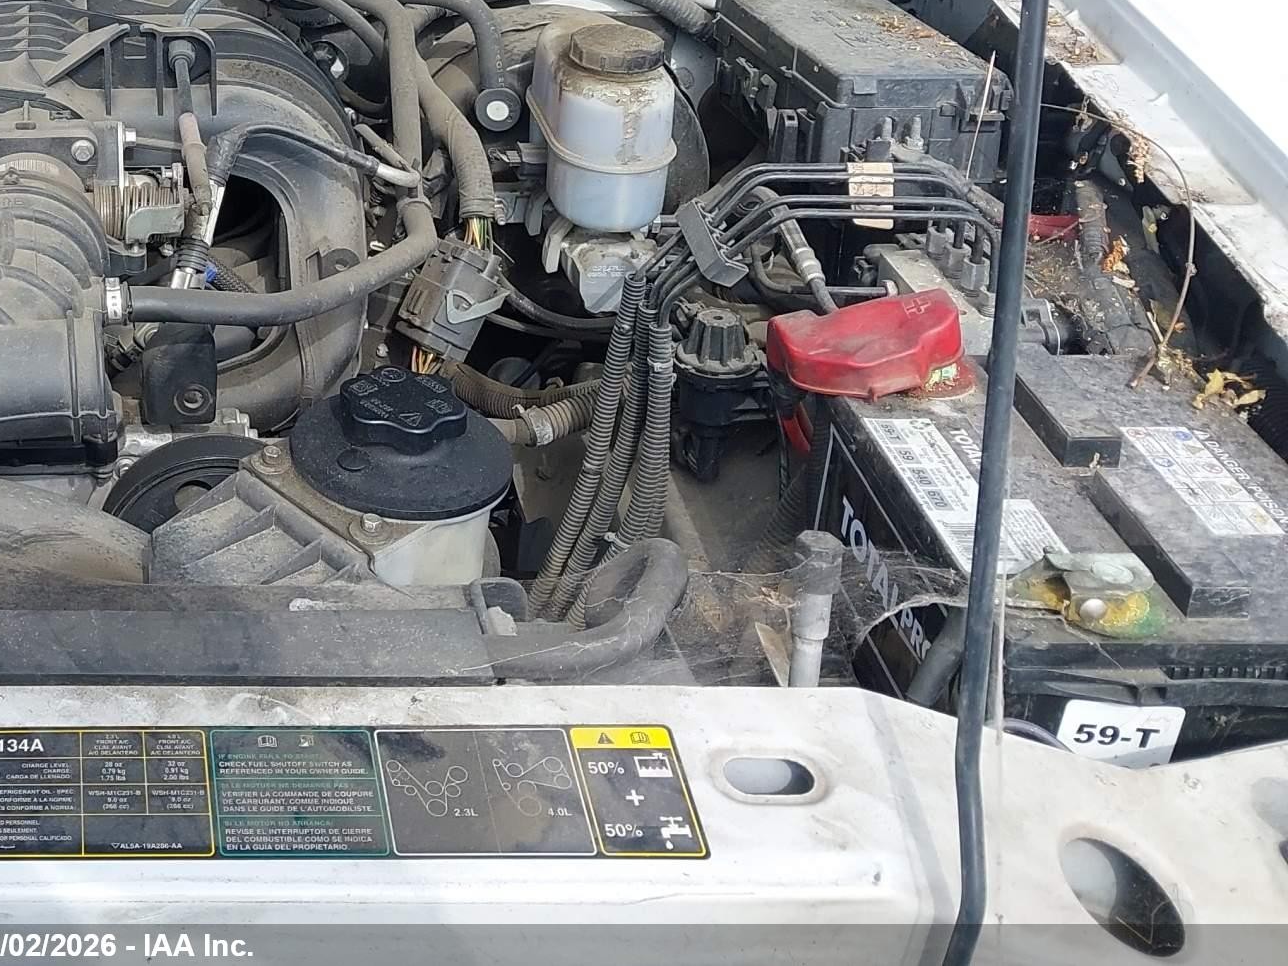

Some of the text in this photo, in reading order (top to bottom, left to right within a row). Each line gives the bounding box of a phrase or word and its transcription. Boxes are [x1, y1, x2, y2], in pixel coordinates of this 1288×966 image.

[899, 450, 914, 462] 59
[912, 469, 932, 486] 540
[928, 490, 948, 509] 670
[1073, 724, 1160, 749] 59-T
[588, 761, 625, 774] 50%
[454, 808, 478, 817] 2.3L
[547, 808, 572, 817] 4.0L
[605, 823, 643, 837] 50%
